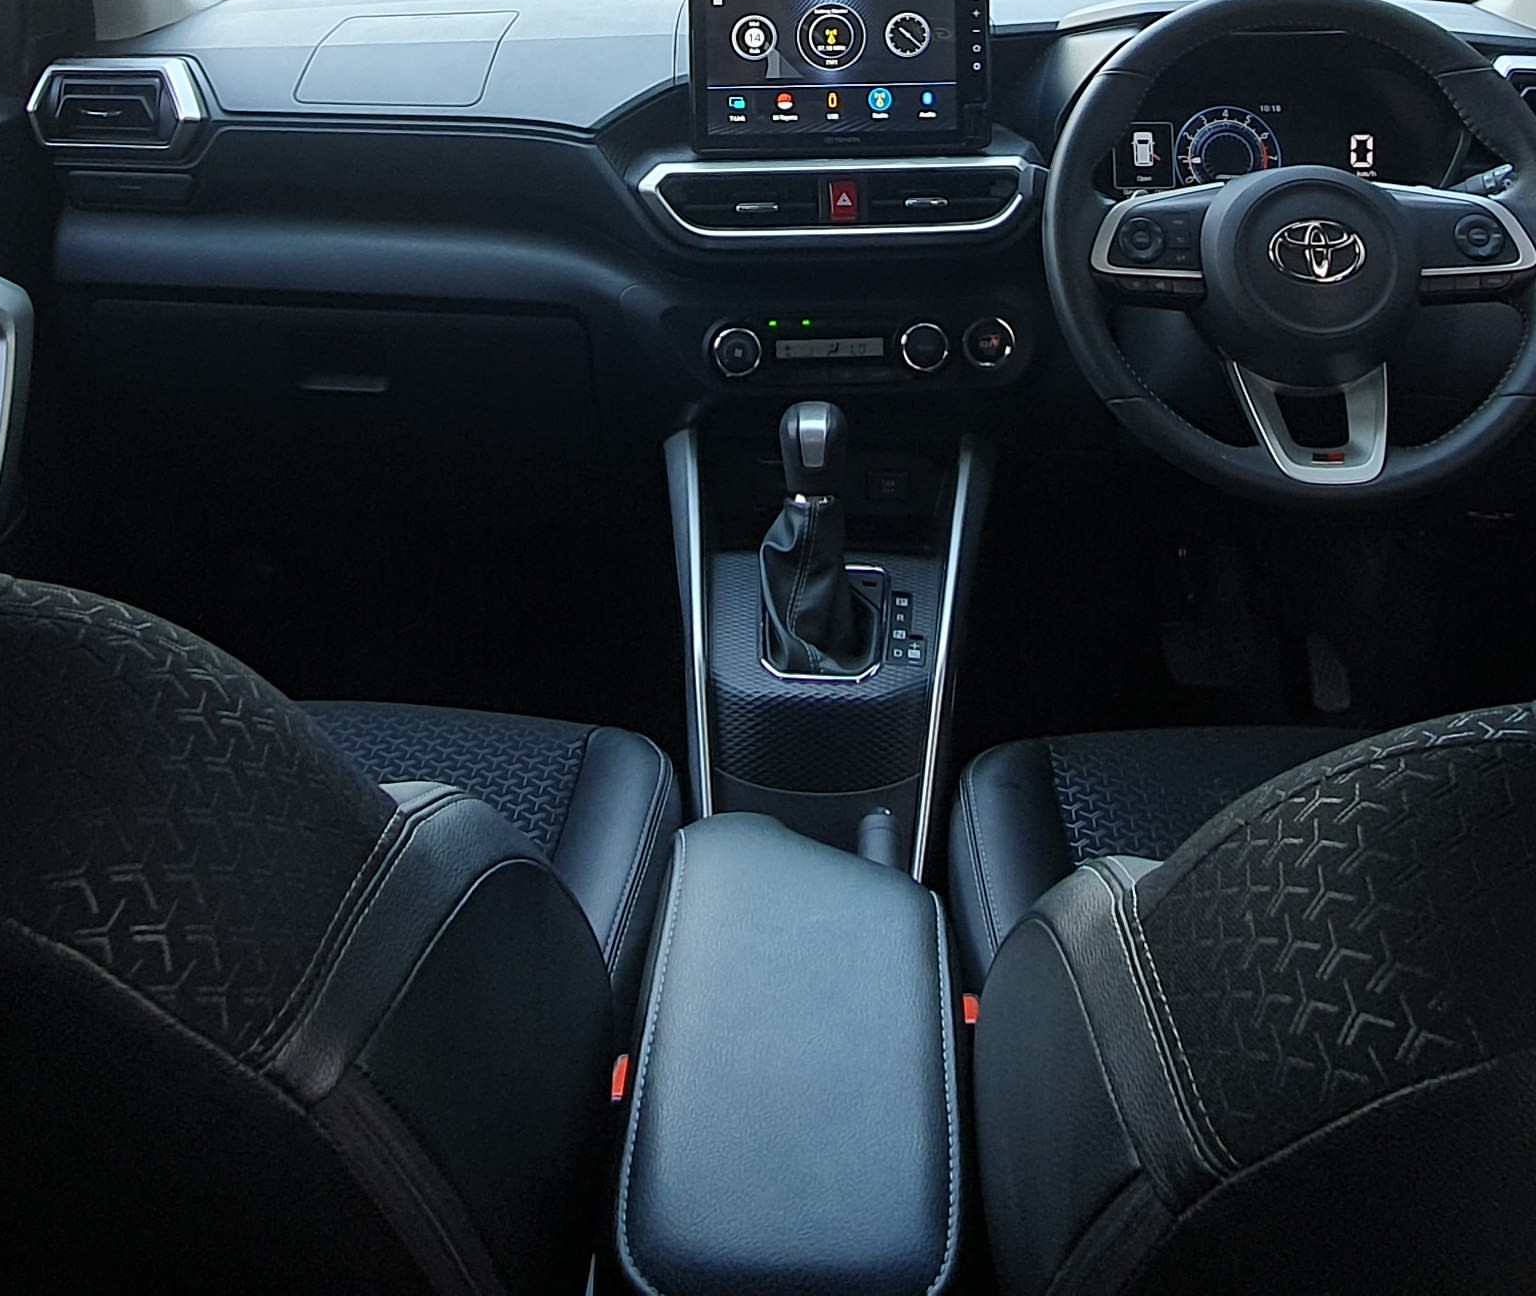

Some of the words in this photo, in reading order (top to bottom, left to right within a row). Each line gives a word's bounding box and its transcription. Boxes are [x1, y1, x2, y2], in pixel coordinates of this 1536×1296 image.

[749, 33, 761, 44] 14
[1222, 109, 1229, 117] 4
[1350, 134, 1373, 167] 0
